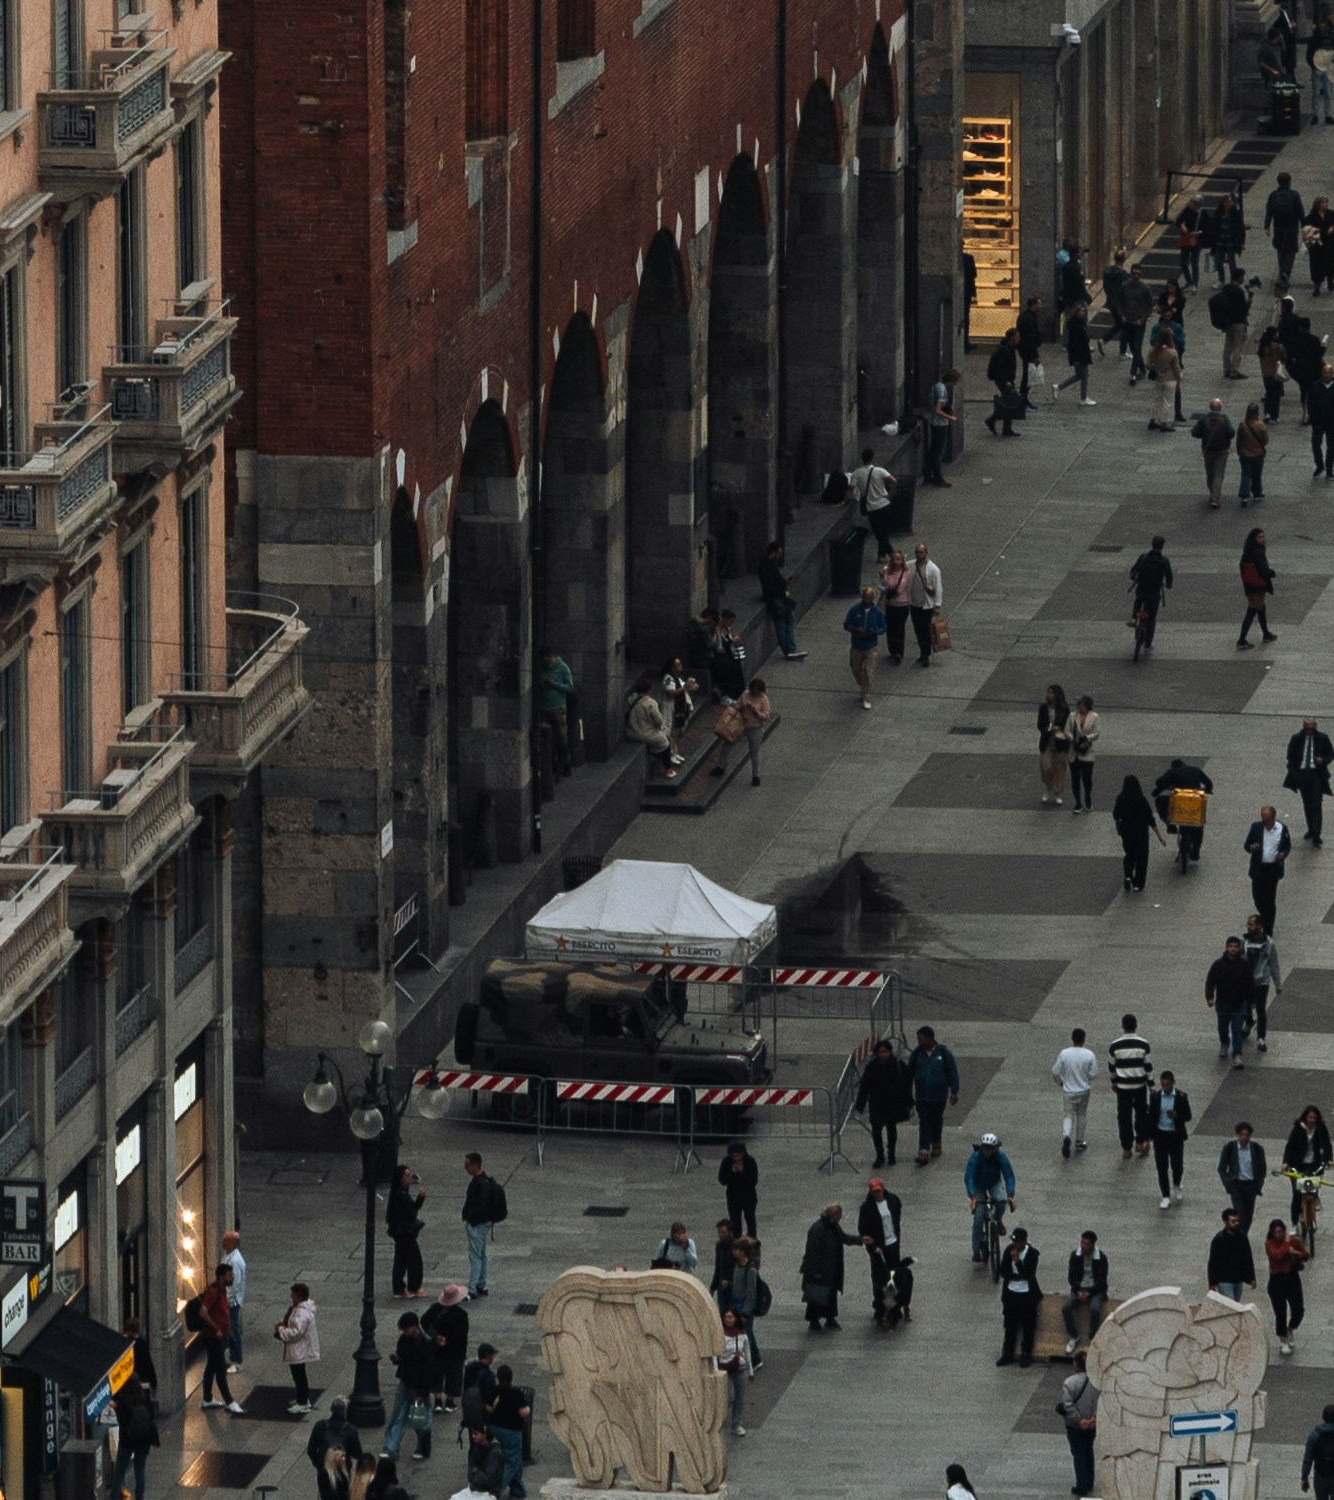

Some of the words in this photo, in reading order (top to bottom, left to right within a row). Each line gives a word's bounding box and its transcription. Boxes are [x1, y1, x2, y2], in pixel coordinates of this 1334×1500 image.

[572, 941, 616, 951] ESERCITO
[677, 946, 721, 957] ESERCITO
[4, 1245, 38, 1260] BAR
[4, 1294, 26, 1329] change
[45, 1378, 55, 1454] hange
